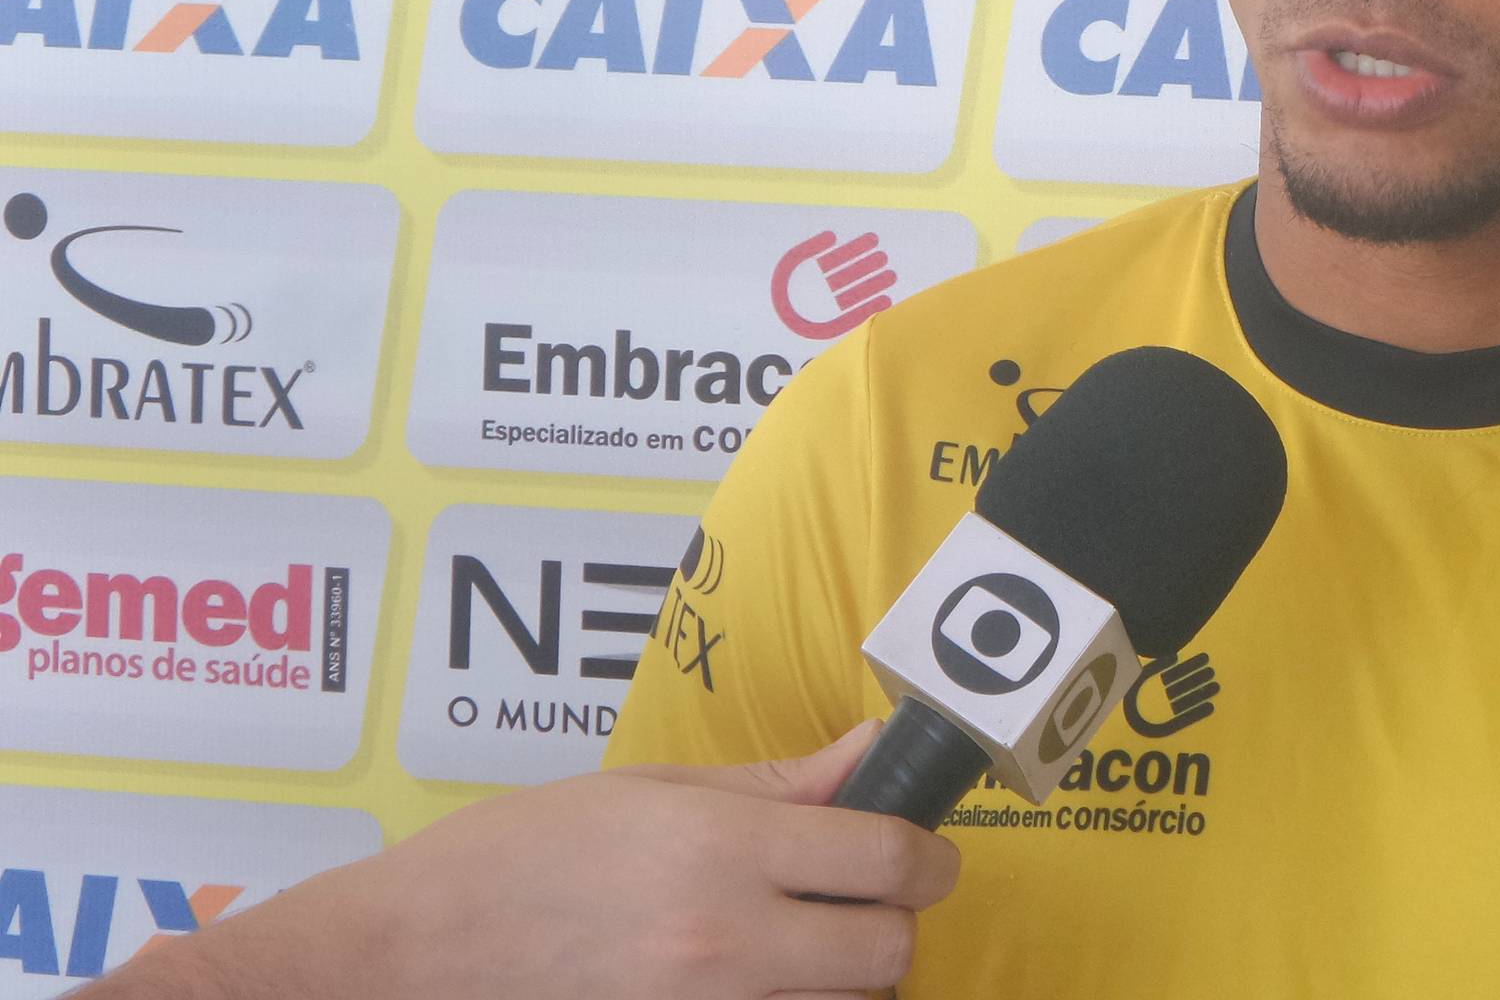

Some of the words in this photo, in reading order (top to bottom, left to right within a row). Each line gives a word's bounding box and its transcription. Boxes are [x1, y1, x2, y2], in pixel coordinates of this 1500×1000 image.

[482, 322, 815, 406] Embrac
[482, 420, 638, 449] Especializado
[646, 432, 683, 451] em
[27, 640, 144, 680] planos
[151, 647, 197, 682] de
[204, 653, 311, 690] saúde
[329, 652, 341, 682] ANS
[448, 695, 478, 727] O
[1022, 810, 1051, 828] em
[1056, 800, 1206, 837] consórcio
